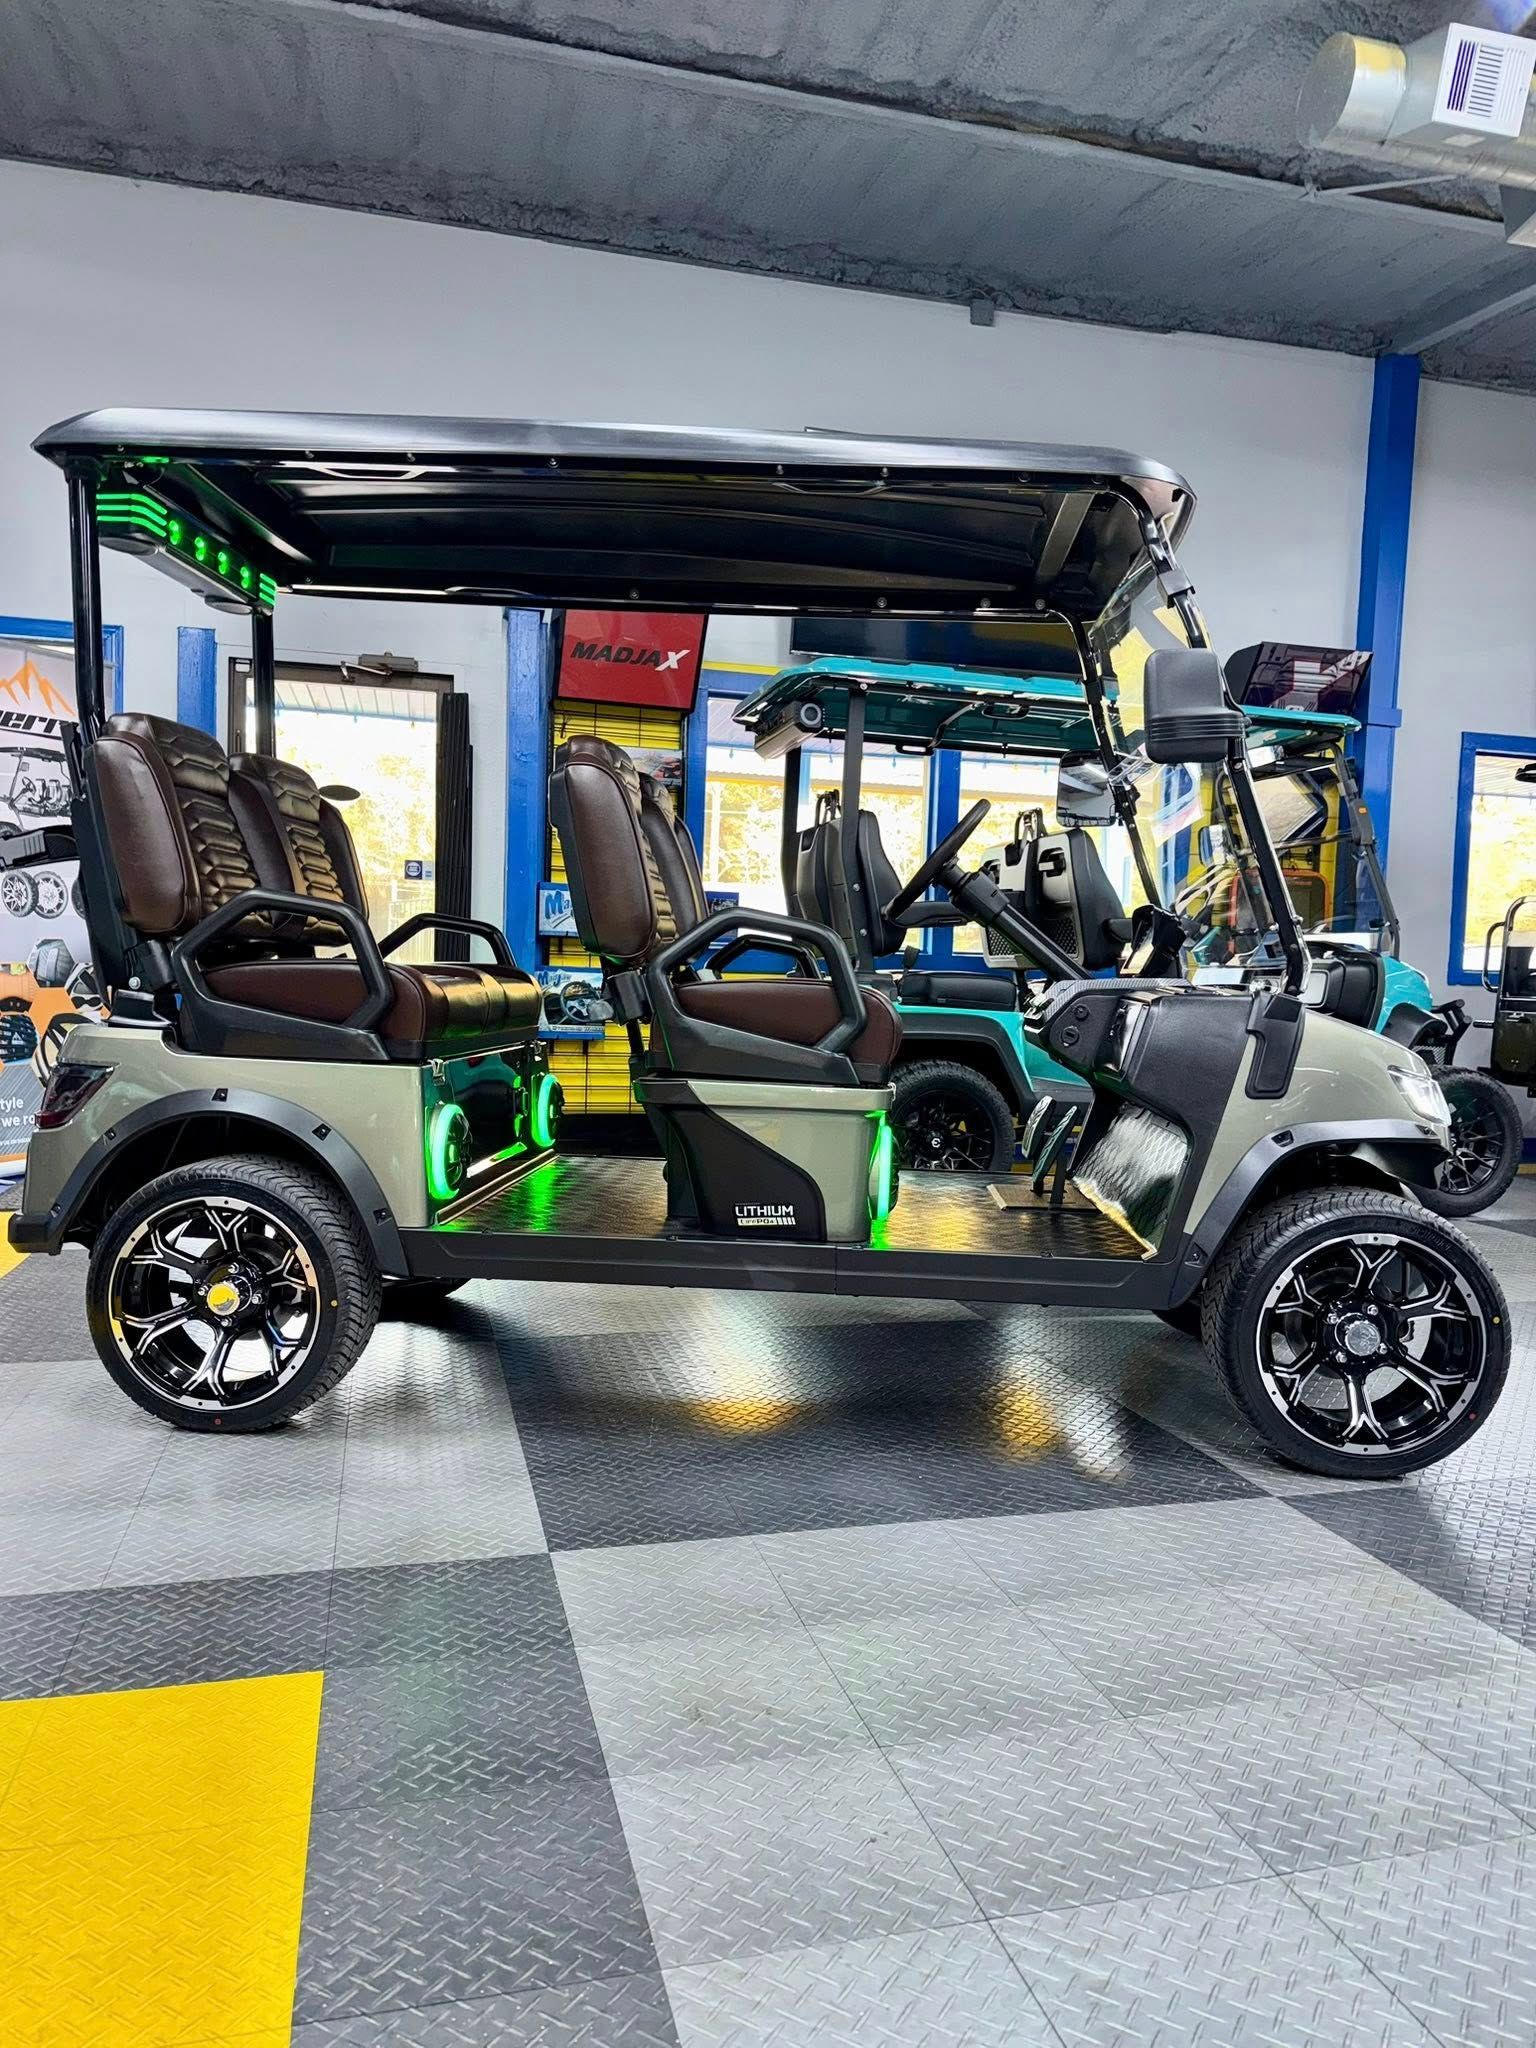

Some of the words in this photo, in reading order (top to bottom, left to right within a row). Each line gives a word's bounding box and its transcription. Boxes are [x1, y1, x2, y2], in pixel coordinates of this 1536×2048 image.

[570, 641, 691, 671] MADJAX
[1, 1116, 20, 1127] we
[735, 1205, 794, 1216] LITHIUM
